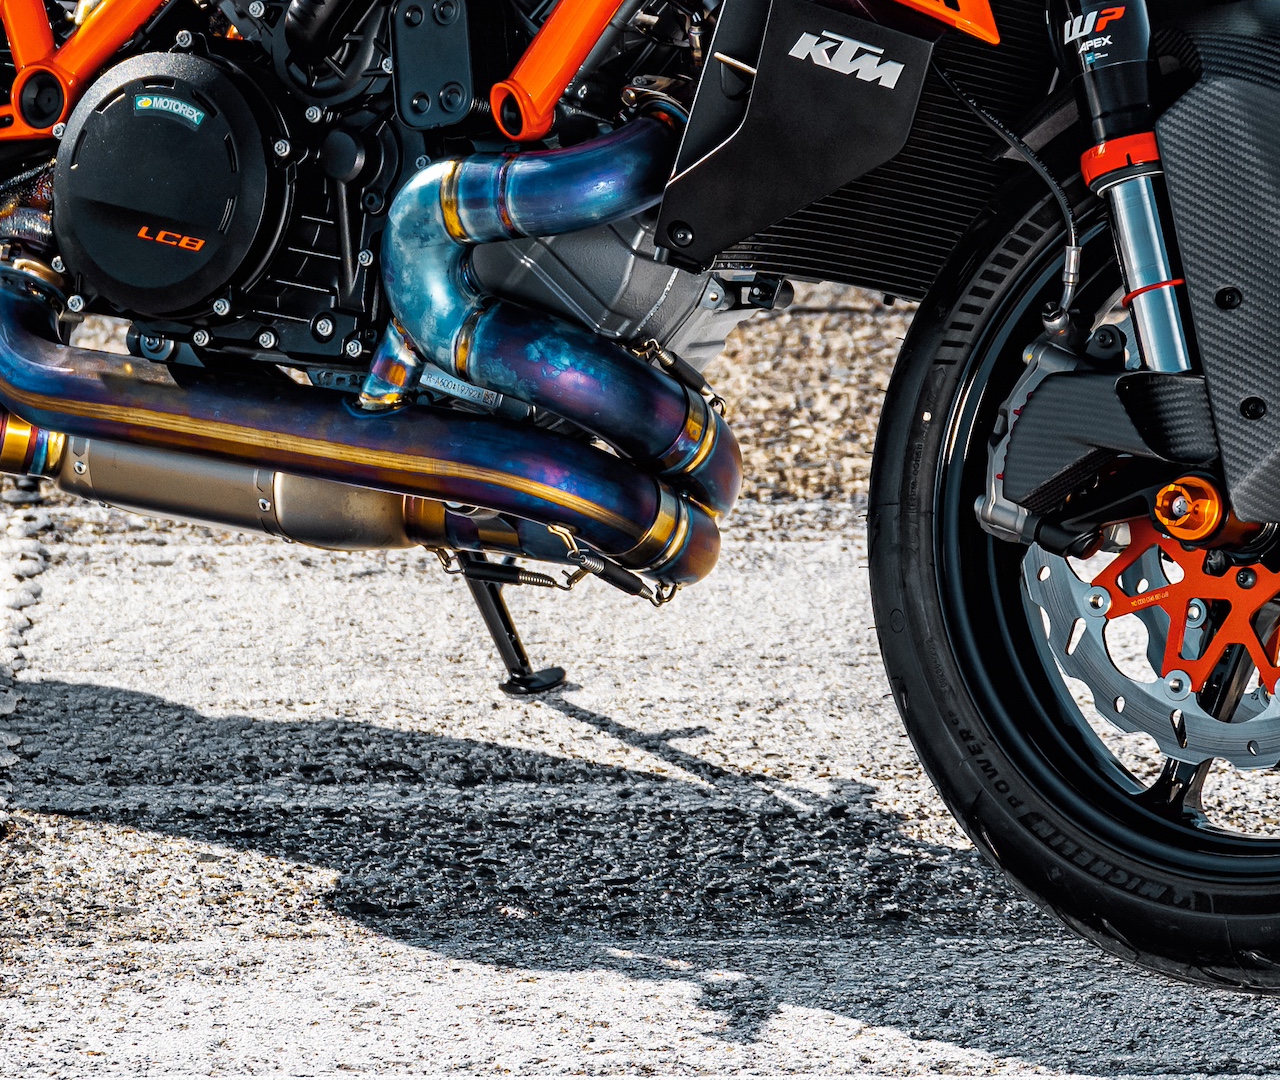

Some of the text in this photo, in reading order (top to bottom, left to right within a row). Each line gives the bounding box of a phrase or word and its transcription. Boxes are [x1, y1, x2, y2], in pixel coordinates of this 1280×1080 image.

[1064, 6, 1126, 45] WP
[1078, 35, 1113, 54] APEX
[788, 30, 905, 90] KTM
[152, 97, 200, 122] MOTOREX
[137, 226, 205, 252] LC8
[958, 727, 1024, 808] POWER
[1031, 820, 1169, 900] MICHELIN
